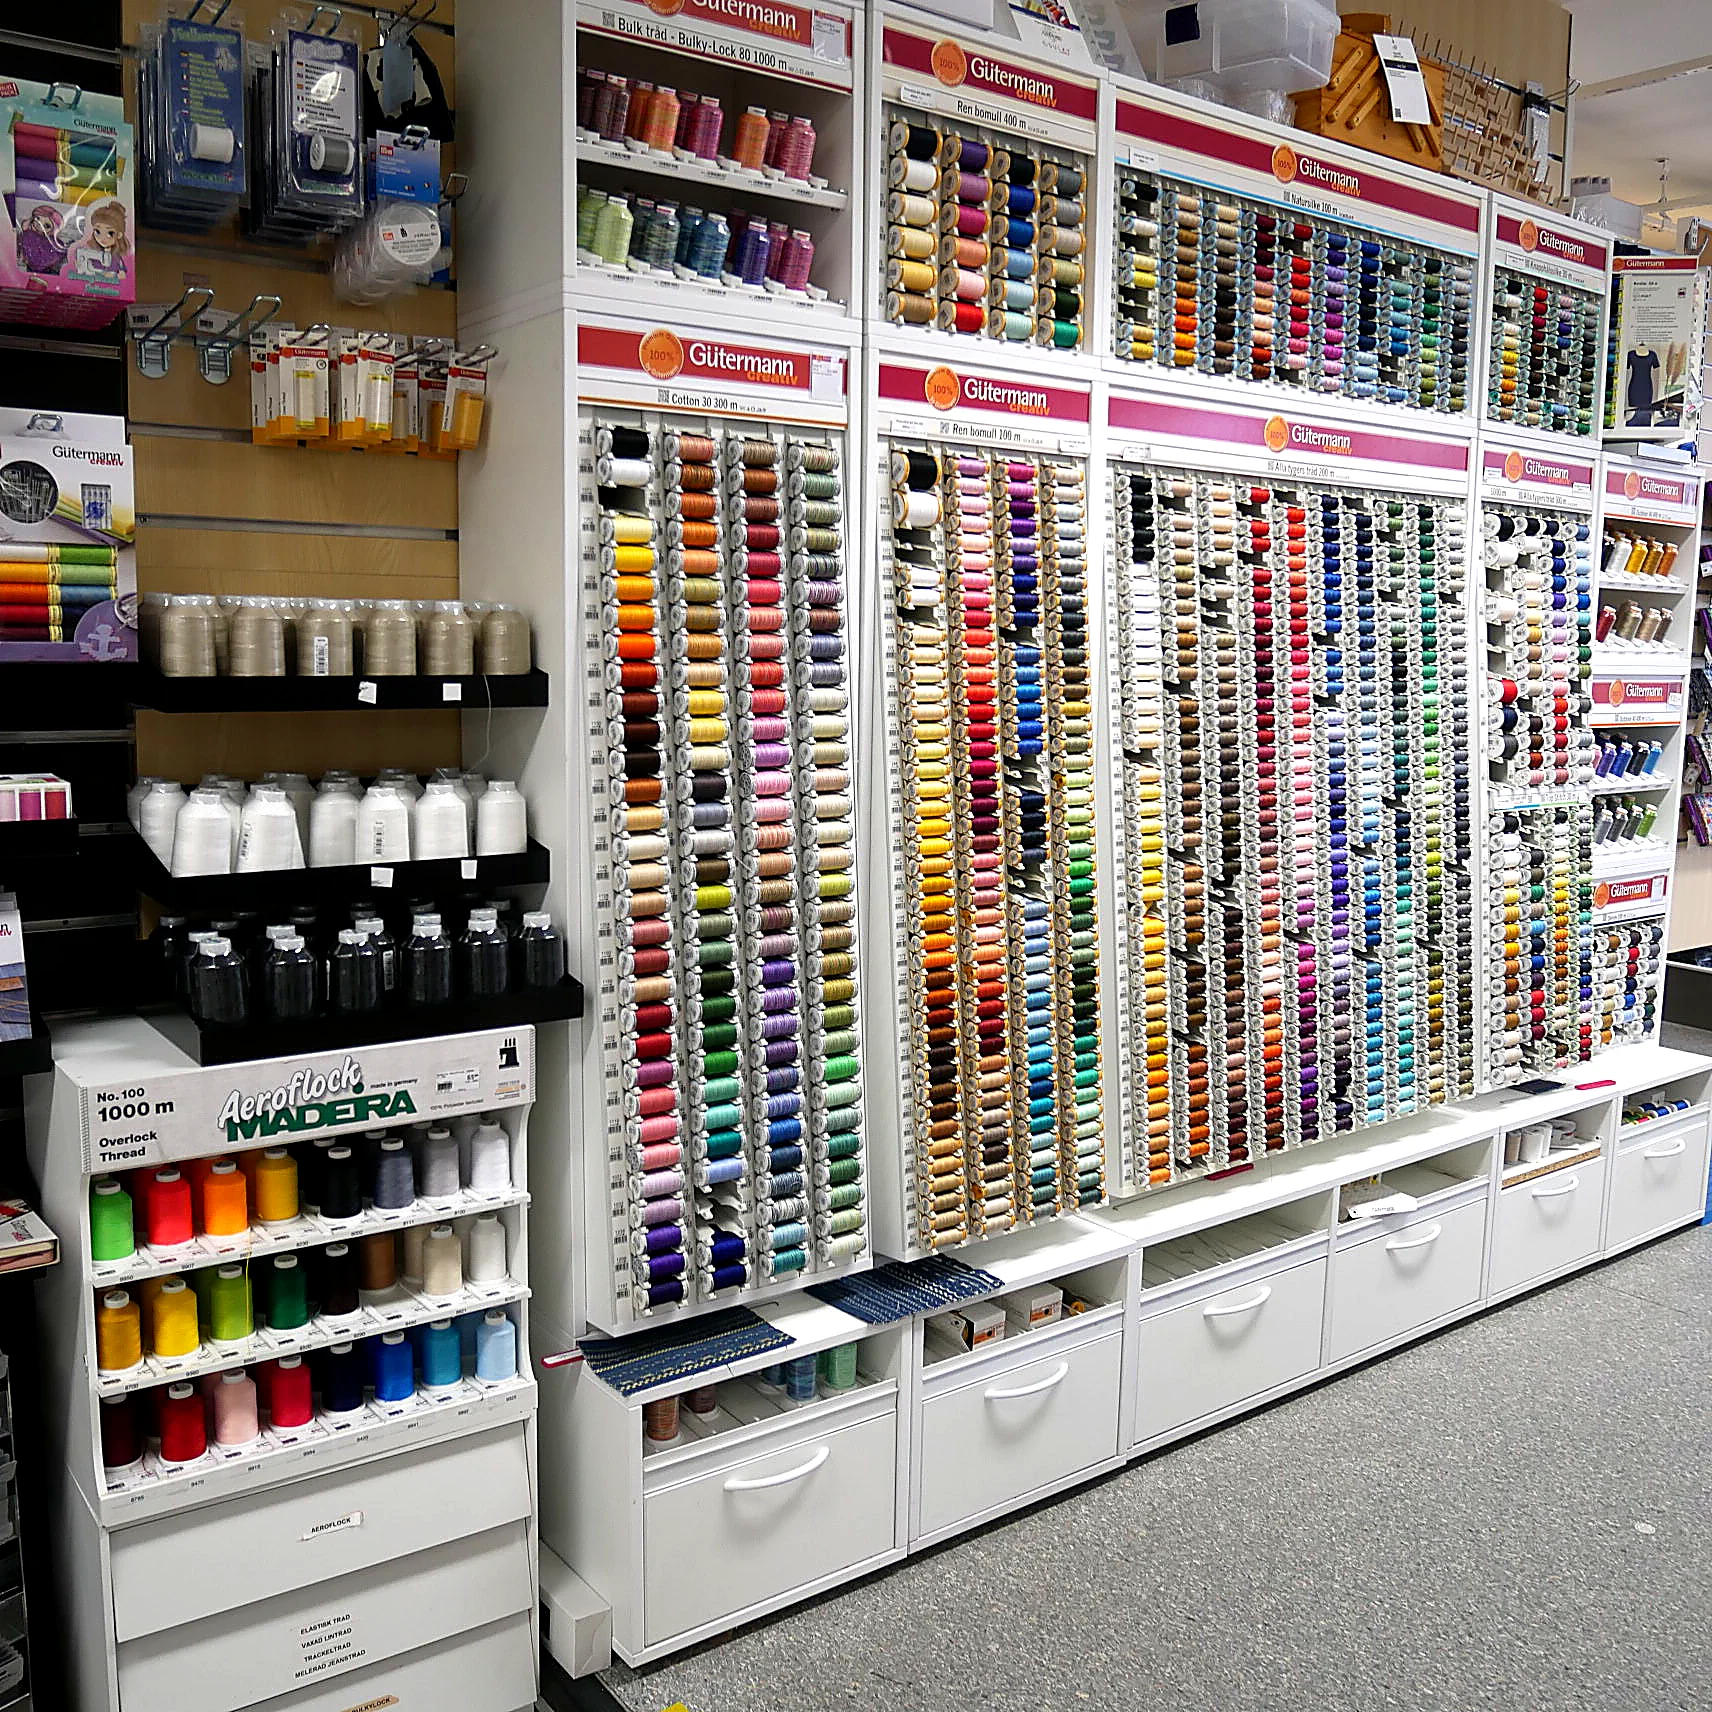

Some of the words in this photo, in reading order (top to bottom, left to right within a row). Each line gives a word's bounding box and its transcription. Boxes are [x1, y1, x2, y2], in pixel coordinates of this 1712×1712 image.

[618, 17, 643, 36] Bulk
[646, 24, 667, 42] tråd
[678, 32, 737, 58] Bulky-Lock
[739, 47, 751, 62] 80
[754, 50, 776, 67] 1000
[778, 59, 788, 71] m
[970, 57, 1054, 100] Gütermann
[1016, 88, 1057, 108] creativ
[957, 100, 973, 116] Ren
[975, 103, 1002, 123] bomull
[1004, 113, 1017, 127] 400
[1019, 121, 1027, 130] m
[74, 119, 116, 132] Gütermann
[1300, 157, 1359, 190] Gütermann
[1331, 181, 1361, 197] creativ
[1540, 230, 1584, 257] Gütermann
[689, 342, 795, 377] Gütermann
[746, 370, 798, 386] creativ
[671, 393, 700, 408] Cotton
[701, 396, 712, 408] 30
[713, 398, 728, 410] 300
[730, 402, 738, 410] m
[964, 378, 1047, 409] Gütermann
[1009, 403, 1050, 416] creativ
[952, 423, 968, 437] Ren
[970, 426, 997, 440] bomull
[999, 429, 1012, 441] 100
[1013, 433, 1021, 442] m
[1291, 424, 1351, 450] Gütermann
[52, 445, 121, 462] Gütermann
[89, 458, 124, 466] creativ
[1525, 459, 1569, 479] Gütermann
[1641, 478, 1679, 496] Gütermann
[1626, 683, 1663, 697] Gütermann
[1611, 882, 1648, 897] Gütermann
[97, 1092, 119, 1103] No.
[121, 1087, 145, 1099] 100
[217, 1055, 362, 1129] Aeroflock
[98, 1102, 150, 1122] 1000
[155, 1101, 174, 1114] m
[99, 1131, 158, 1148] Overlock
[99, 1146, 146, 1162] Thread
[311, 1517, 351, 1533] AEROFLOCK
[300, 1620, 332, 1635] ELASTISK
[294, 1663, 327, 1679] MELERAD
[352, 1697, 390, 1712] BULKYLOCK
